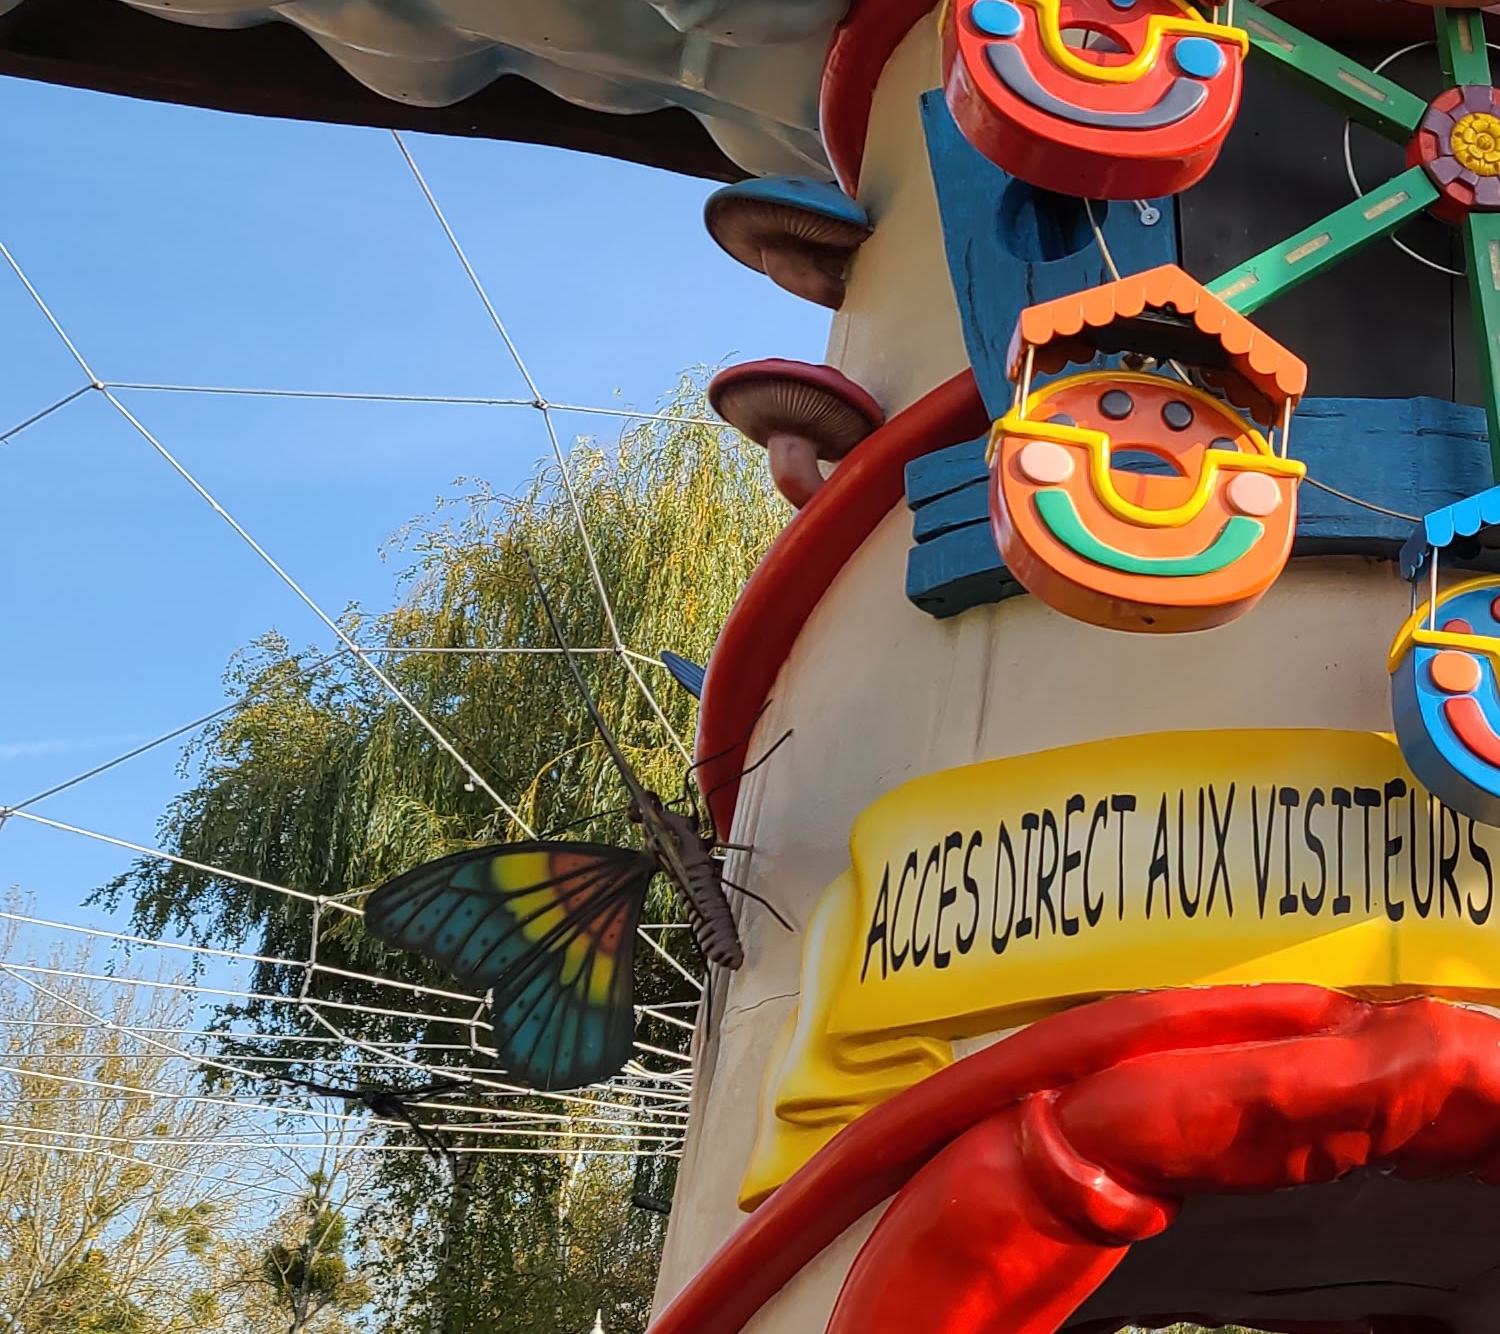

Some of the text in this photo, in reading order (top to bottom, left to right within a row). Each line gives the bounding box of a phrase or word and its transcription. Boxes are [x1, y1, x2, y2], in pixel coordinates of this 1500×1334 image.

[860, 829, 983, 984] ACCES
[990, 793, 1137, 955] DIRECT
[1145, 781, 1236, 920] AUX
[1251, 777, 1494, 925] VISITEURS
